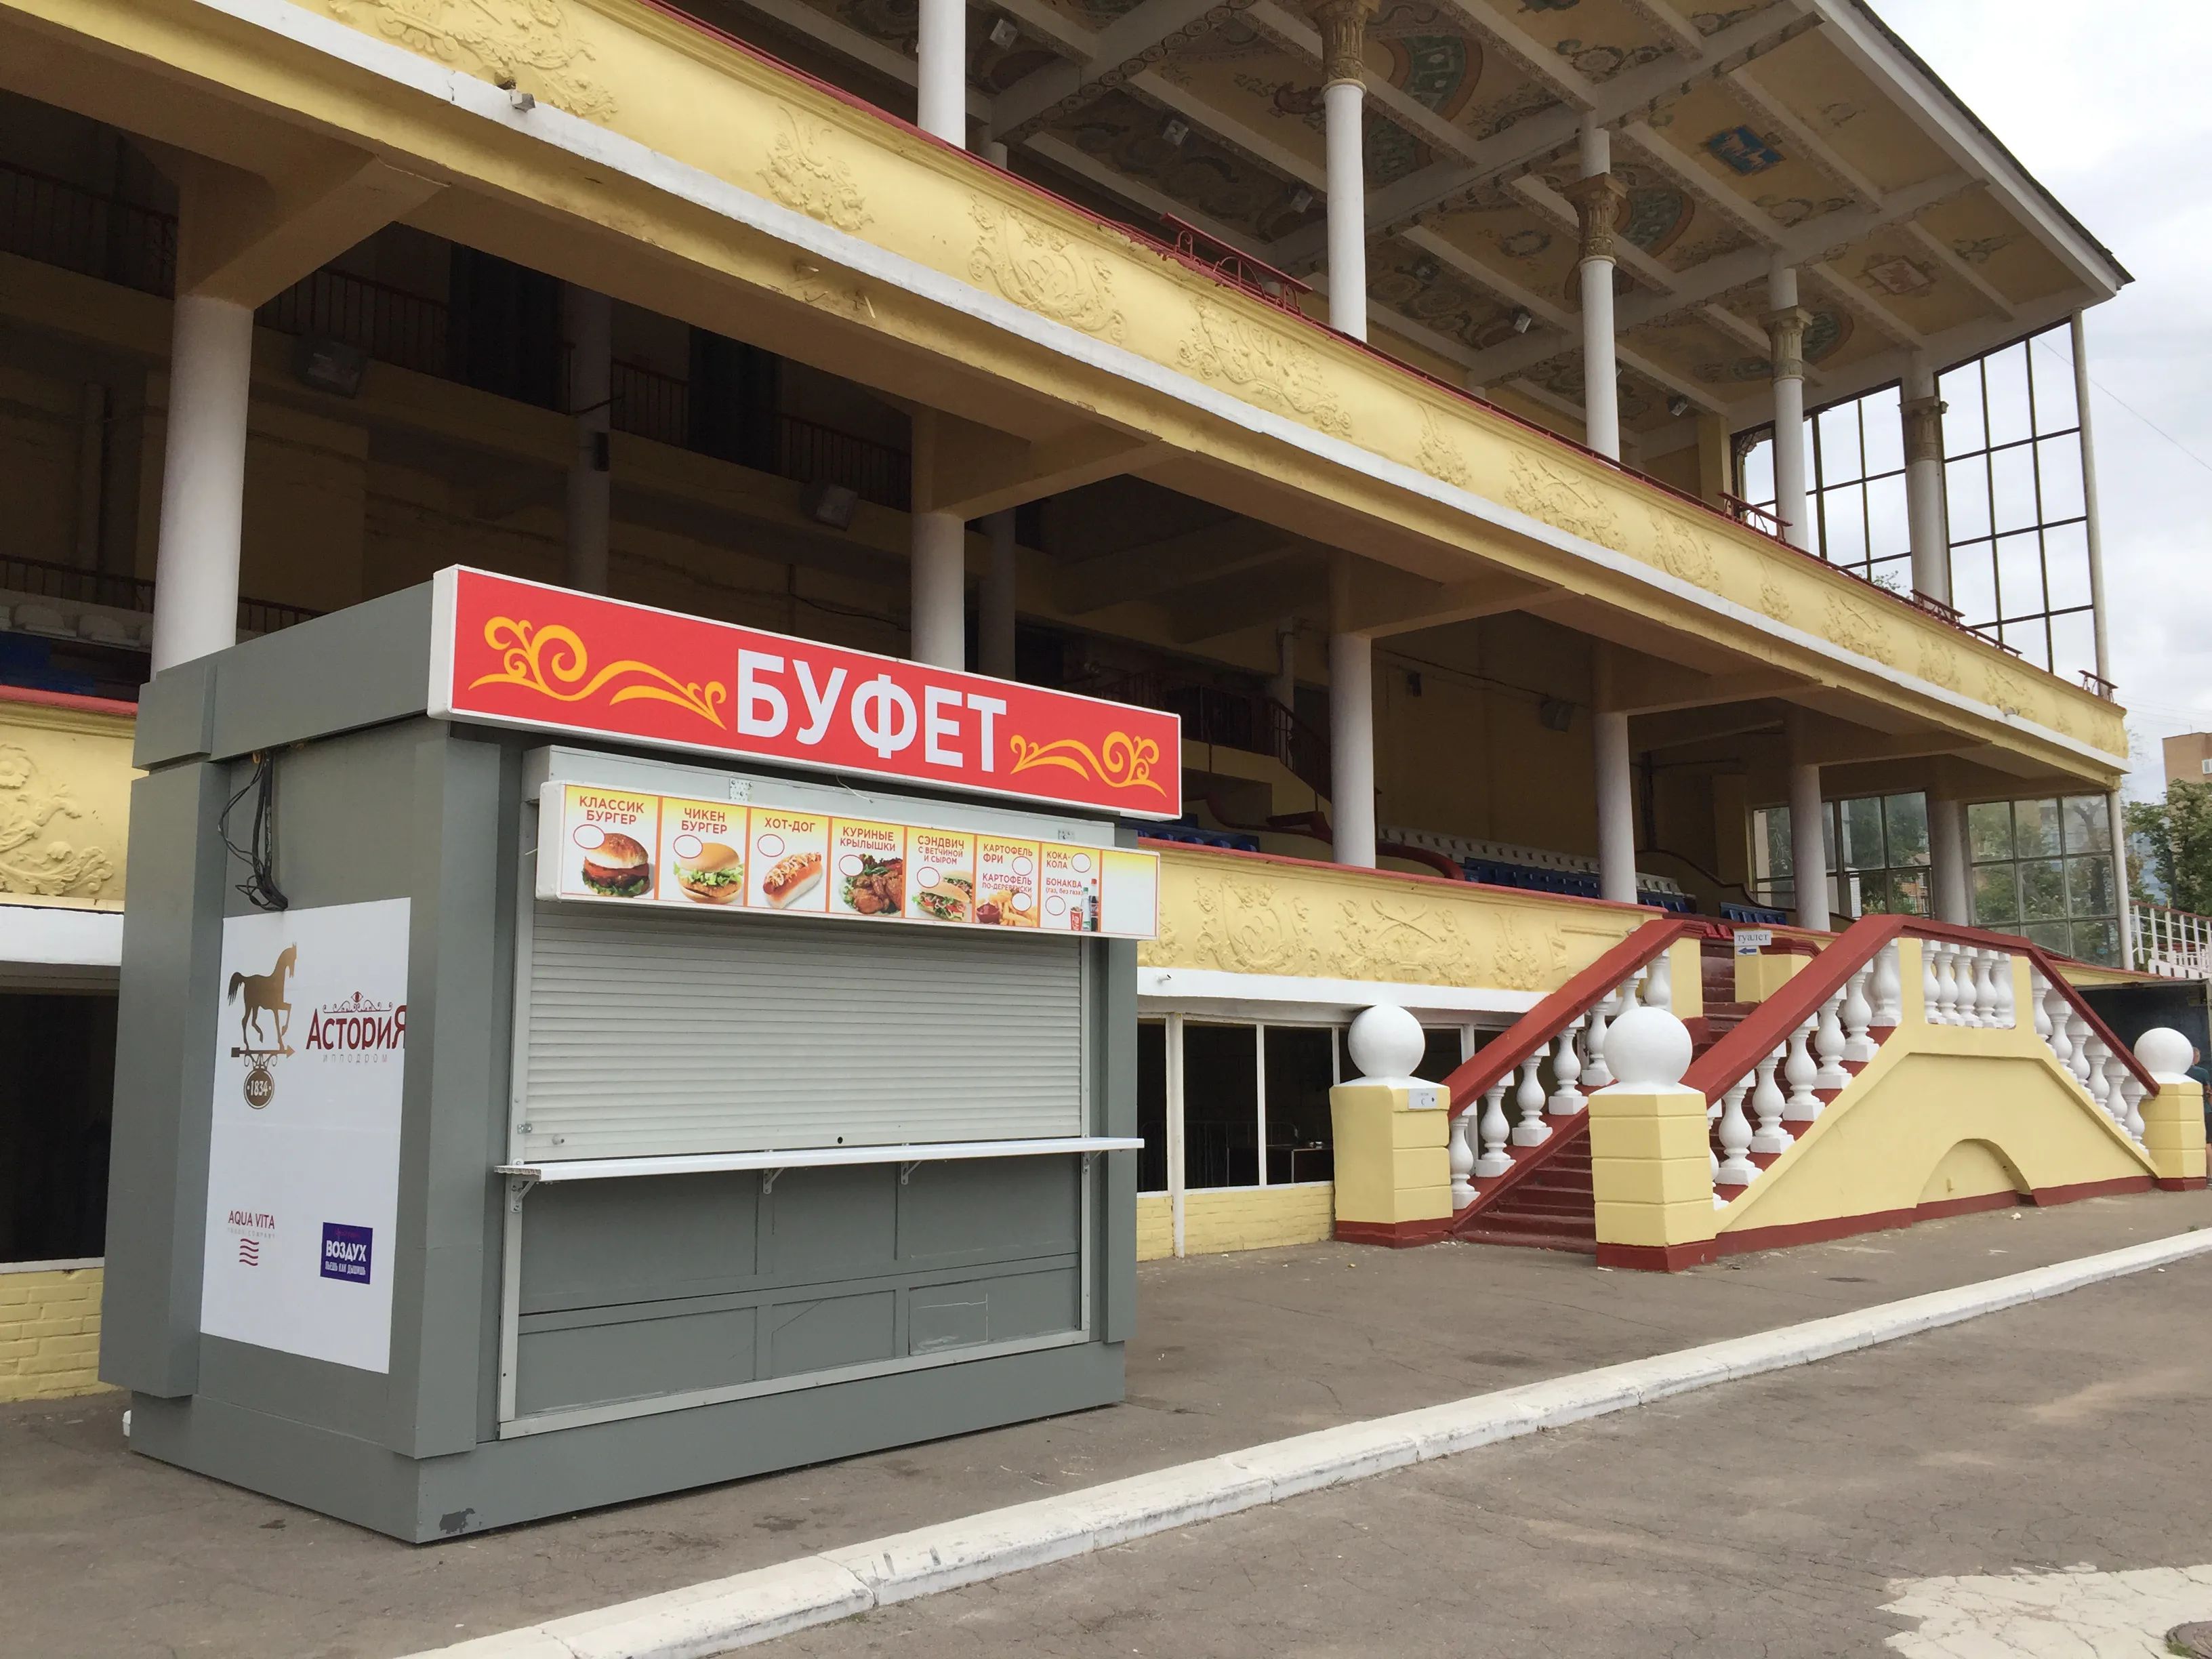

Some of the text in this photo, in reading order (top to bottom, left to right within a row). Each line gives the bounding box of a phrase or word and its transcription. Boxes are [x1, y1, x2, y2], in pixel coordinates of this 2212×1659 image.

[736, 649, 1007, 773] БУФЕТ
[579, 796, 644, 813] КЛАССИК
[586, 809, 637, 825] БУРГЕР
[684, 808, 726, 823] ЧИКЕН
[681, 821, 727, 835] БУРГЕР
[764, 817, 815, 834] ХОТ-ДОГ
[842, 826, 894, 842] КУРИНЫЕ
[840, 838, 895, 852] КРЫЛЫШКИ
[917, 835, 964, 849] СЭНДВИЧ
[925, 848, 963, 858] ВЕТЧИНОЙ
[983, 844, 1033, 857] КАРТОФЕЛЬ
[1046, 851, 1071, 861] КОКА-
[930, 855, 957, 865] СЫРОМ
[983, 853, 1003, 864] ФРИ
[1046, 860, 1067, 869] КОЛА
[983, 873, 1032, 885] КАРТОФЕЛЬ
[1046, 878, 1082, 888] БОНАКВА
[982, 882, 1032, 893] ПО-ДЕРЕВЕНСКИ
[1738, 934, 1767, 943] туалет
[250, 1080, 268, 1096] 1834
[228, 1210, 275, 1229] AQUA VITA
[325, 1240, 367, 1263] ВОЗДУХ
